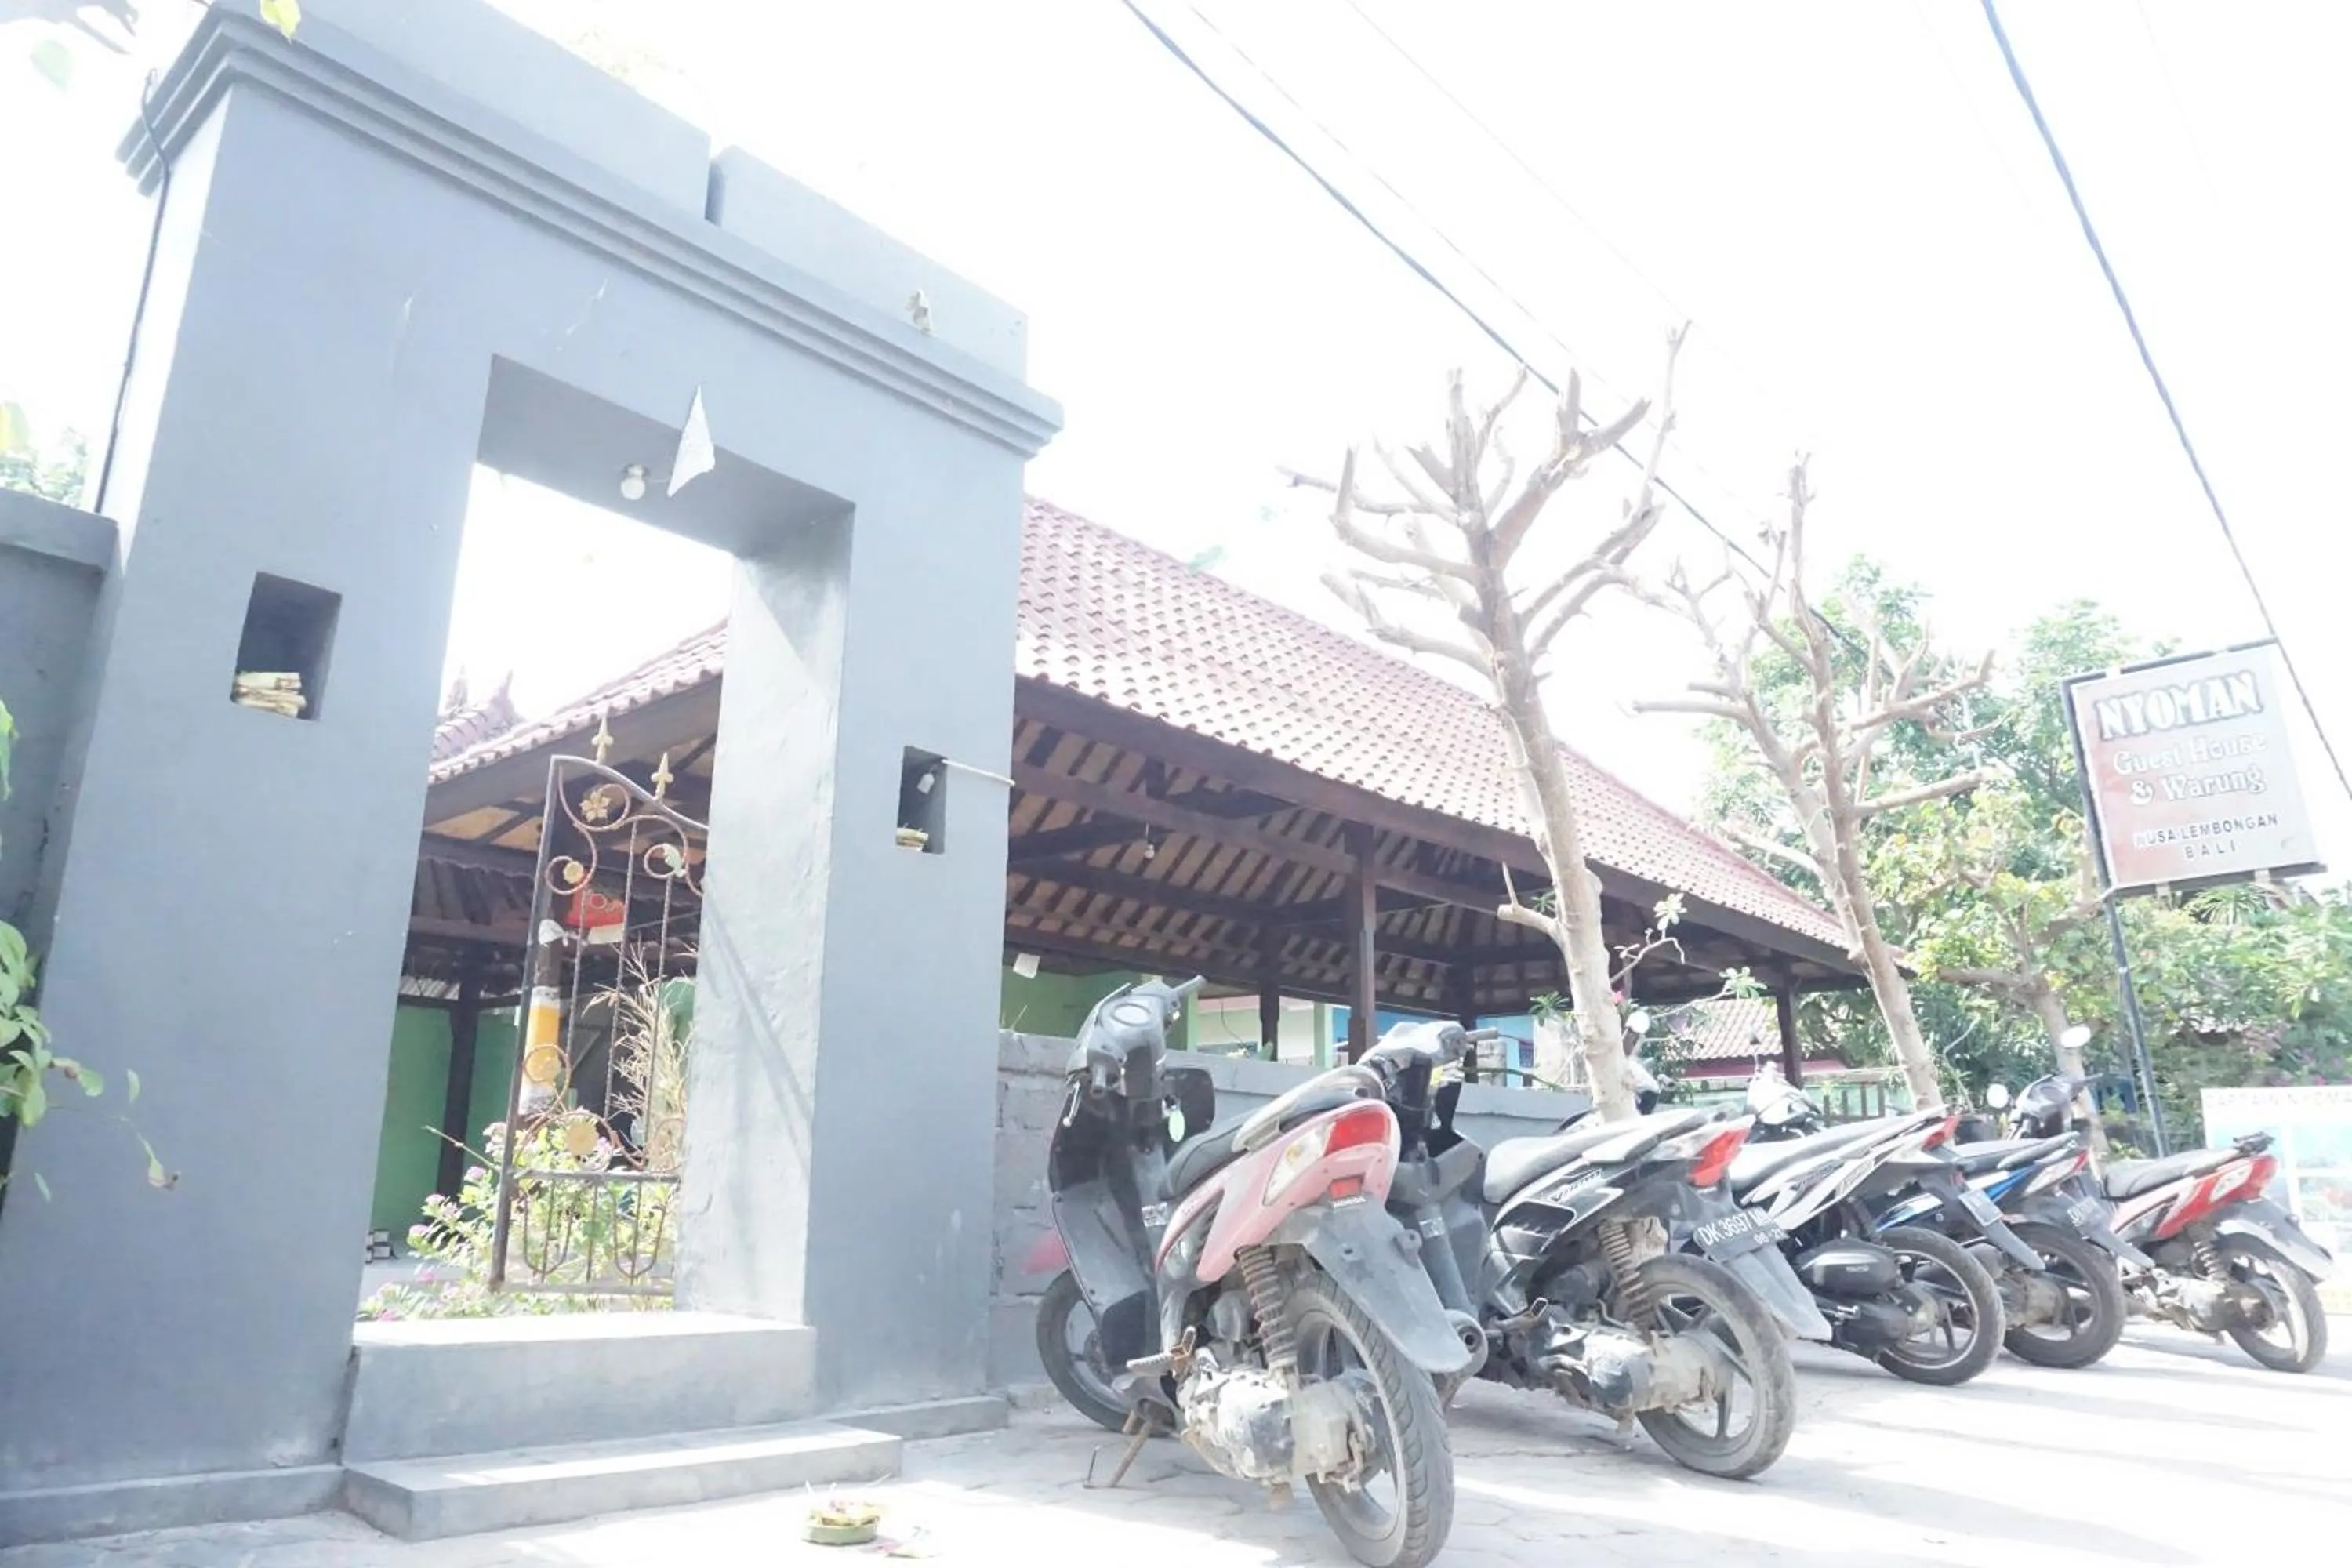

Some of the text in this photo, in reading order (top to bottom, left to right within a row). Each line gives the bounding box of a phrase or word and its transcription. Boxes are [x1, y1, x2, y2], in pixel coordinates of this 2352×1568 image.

[2095, 670, 2263, 740] NYOMAN
[2113, 732, 2268, 775] Guest House
[2129, 764, 2267, 805] & Warung
[2181, 813, 2278, 840] LEMBONGAN
[2185, 841, 2237, 859] BALI
[1697, 1223, 1725, 1246] DK
